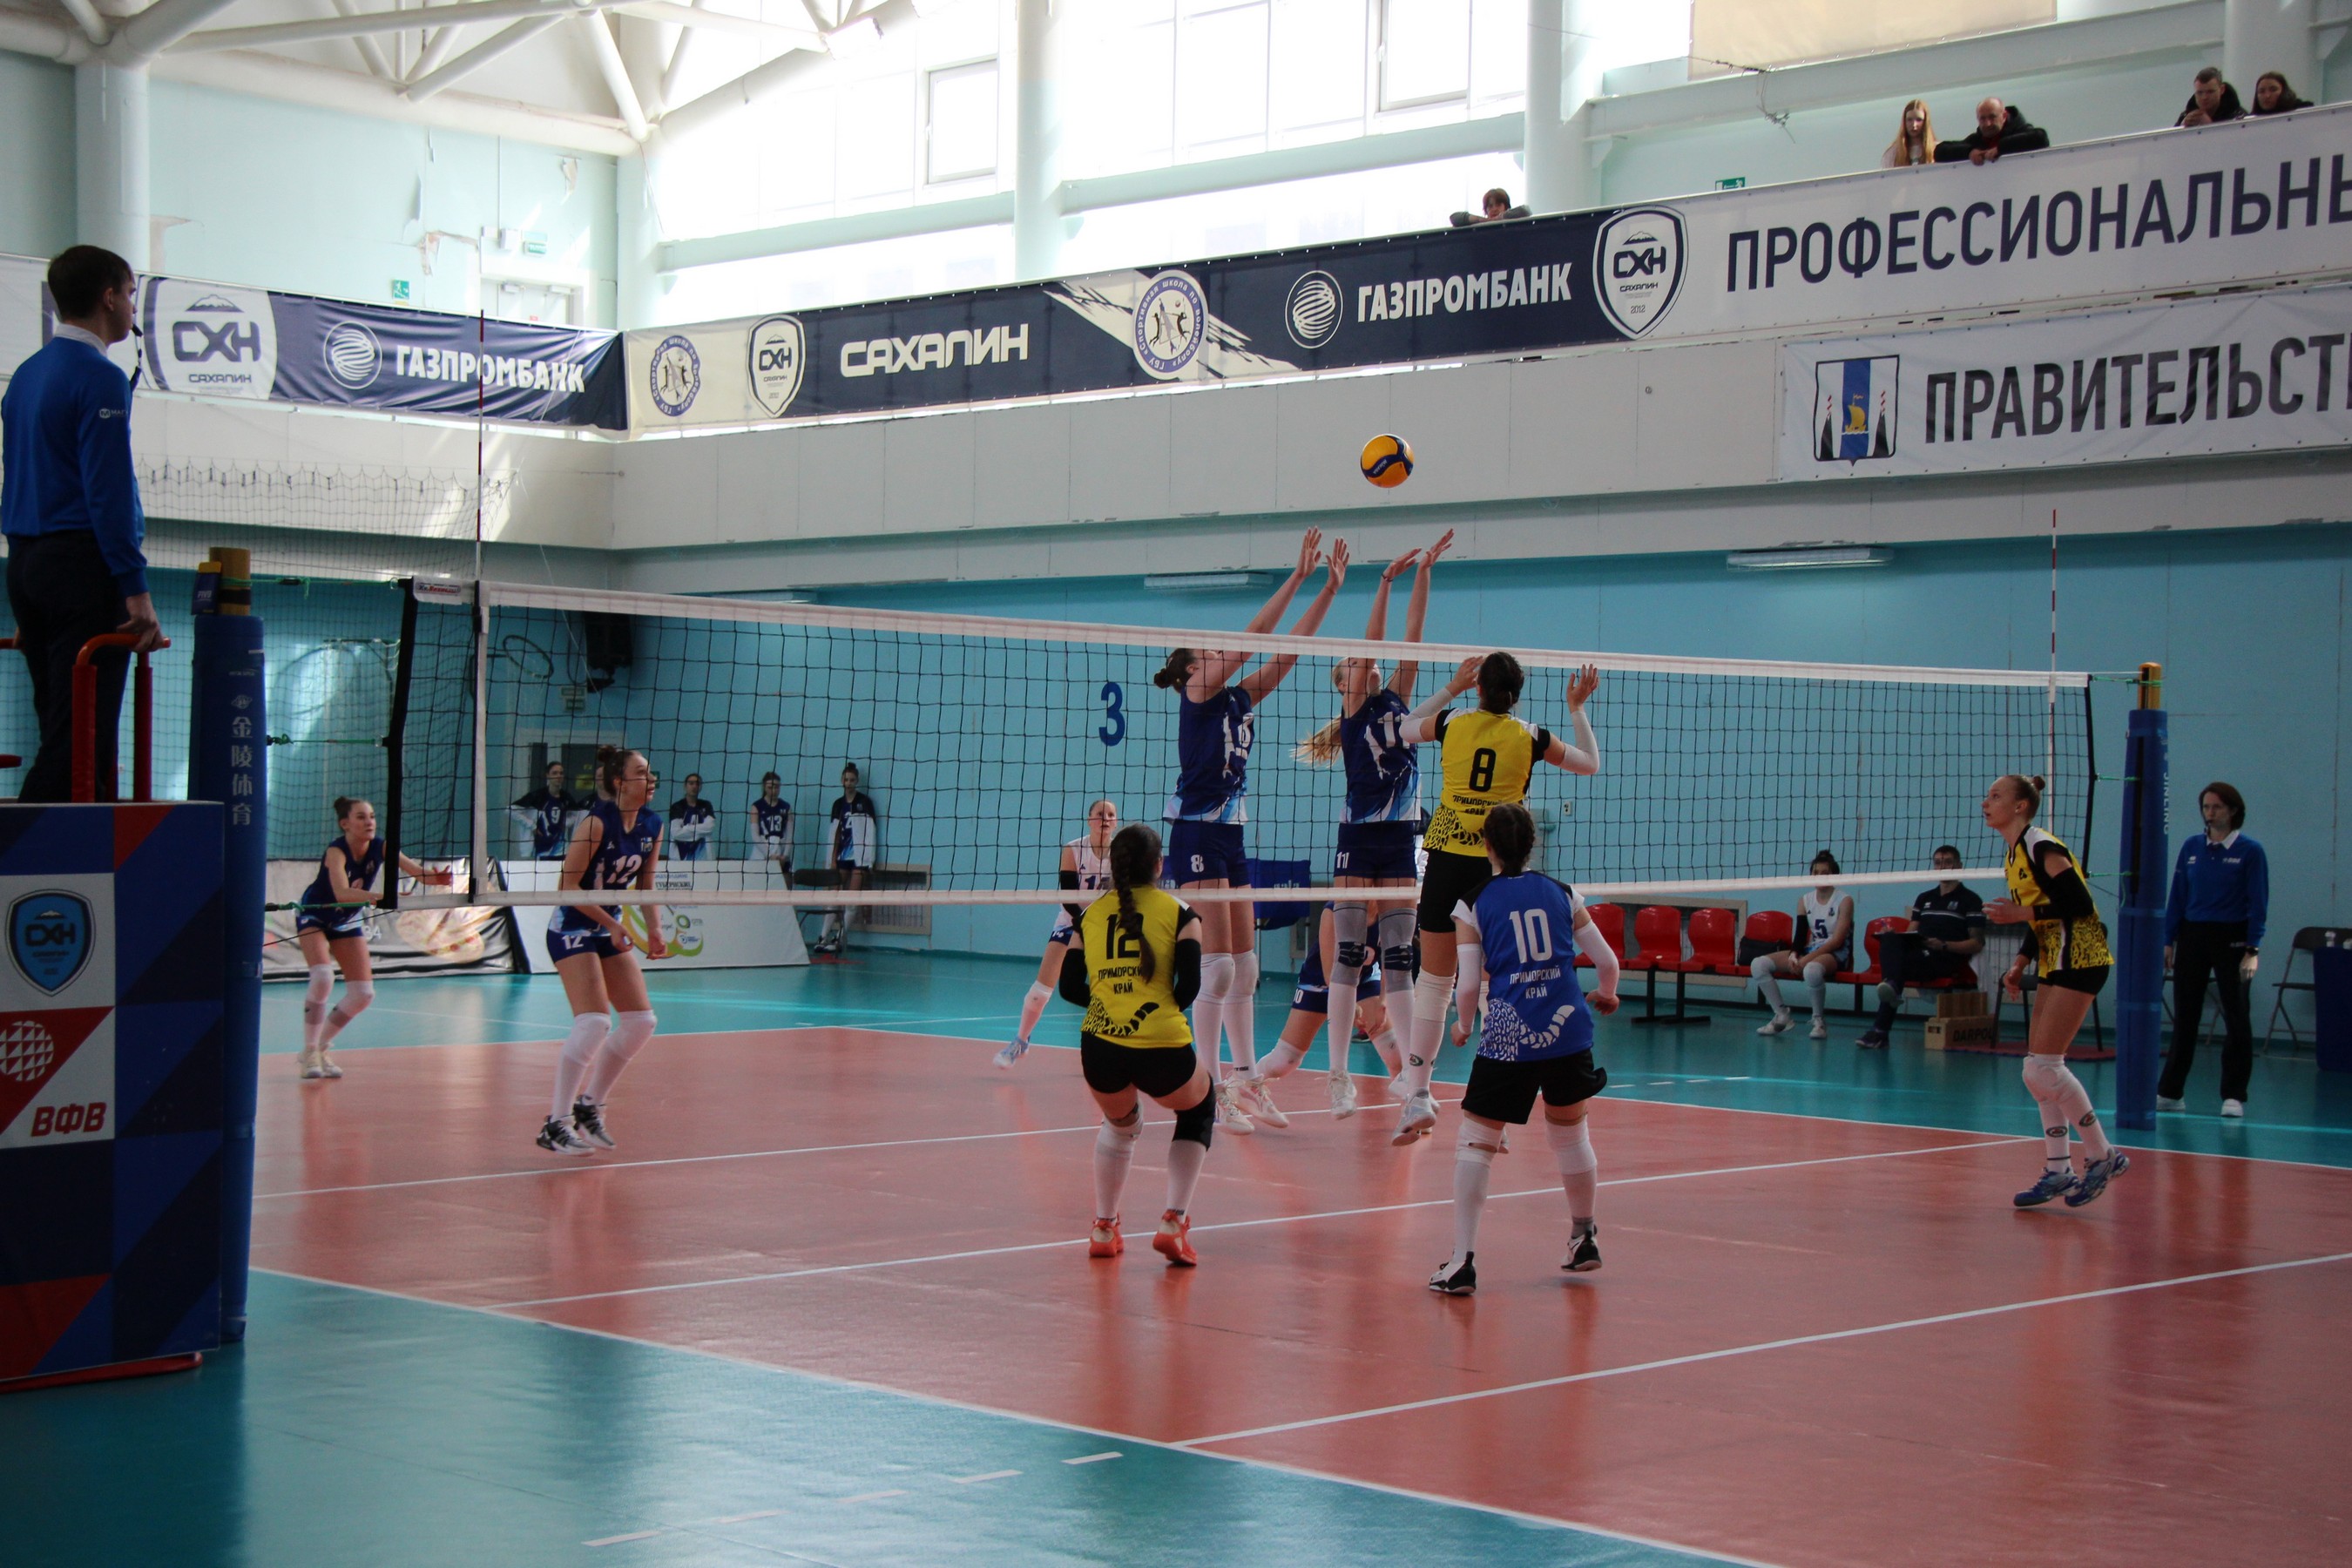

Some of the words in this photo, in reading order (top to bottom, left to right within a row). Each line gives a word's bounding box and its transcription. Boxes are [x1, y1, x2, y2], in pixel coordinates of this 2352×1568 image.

[1357, 262, 1573, 323] ГАЗПРОМБАНК
[1630, 304, 1646, 314] 2012
[840, 323, 1029, 378] САХАЛИН
[188, 374, 252, 383] САХАЛИН
[395, 345, 585, 394] ГАЗПРОМБАНК
[1924, 332, 2352, 444] ПРАВИТЕЛЬСТ
[1098, 681, 1126, 747] 3
[231, 716, 253, 826] 金陵体育
[1469, 747, 1497, 793] 8
[766, 815, 783, 832] 13
[606, 855, 643, 884] 12
[1190, 854, 1205, 874] 8
[561, 934, 585, 950] 12
[1106, 913, 1144, 960] 12
[1508, 908, 1553, 964] 10
[1815, 919, 1829, 939] 5
[1098, 965, 1143, 982] ПРИМОРСКИ
[1113, 978, 1134, 995] КРАЙ
[1510, 964, 1561, 985] ПРИМОРСКИЙ
[1525, 983, 1548, 1000] КРАЙ
[30, 1100, 107, 1138] ВФВ
